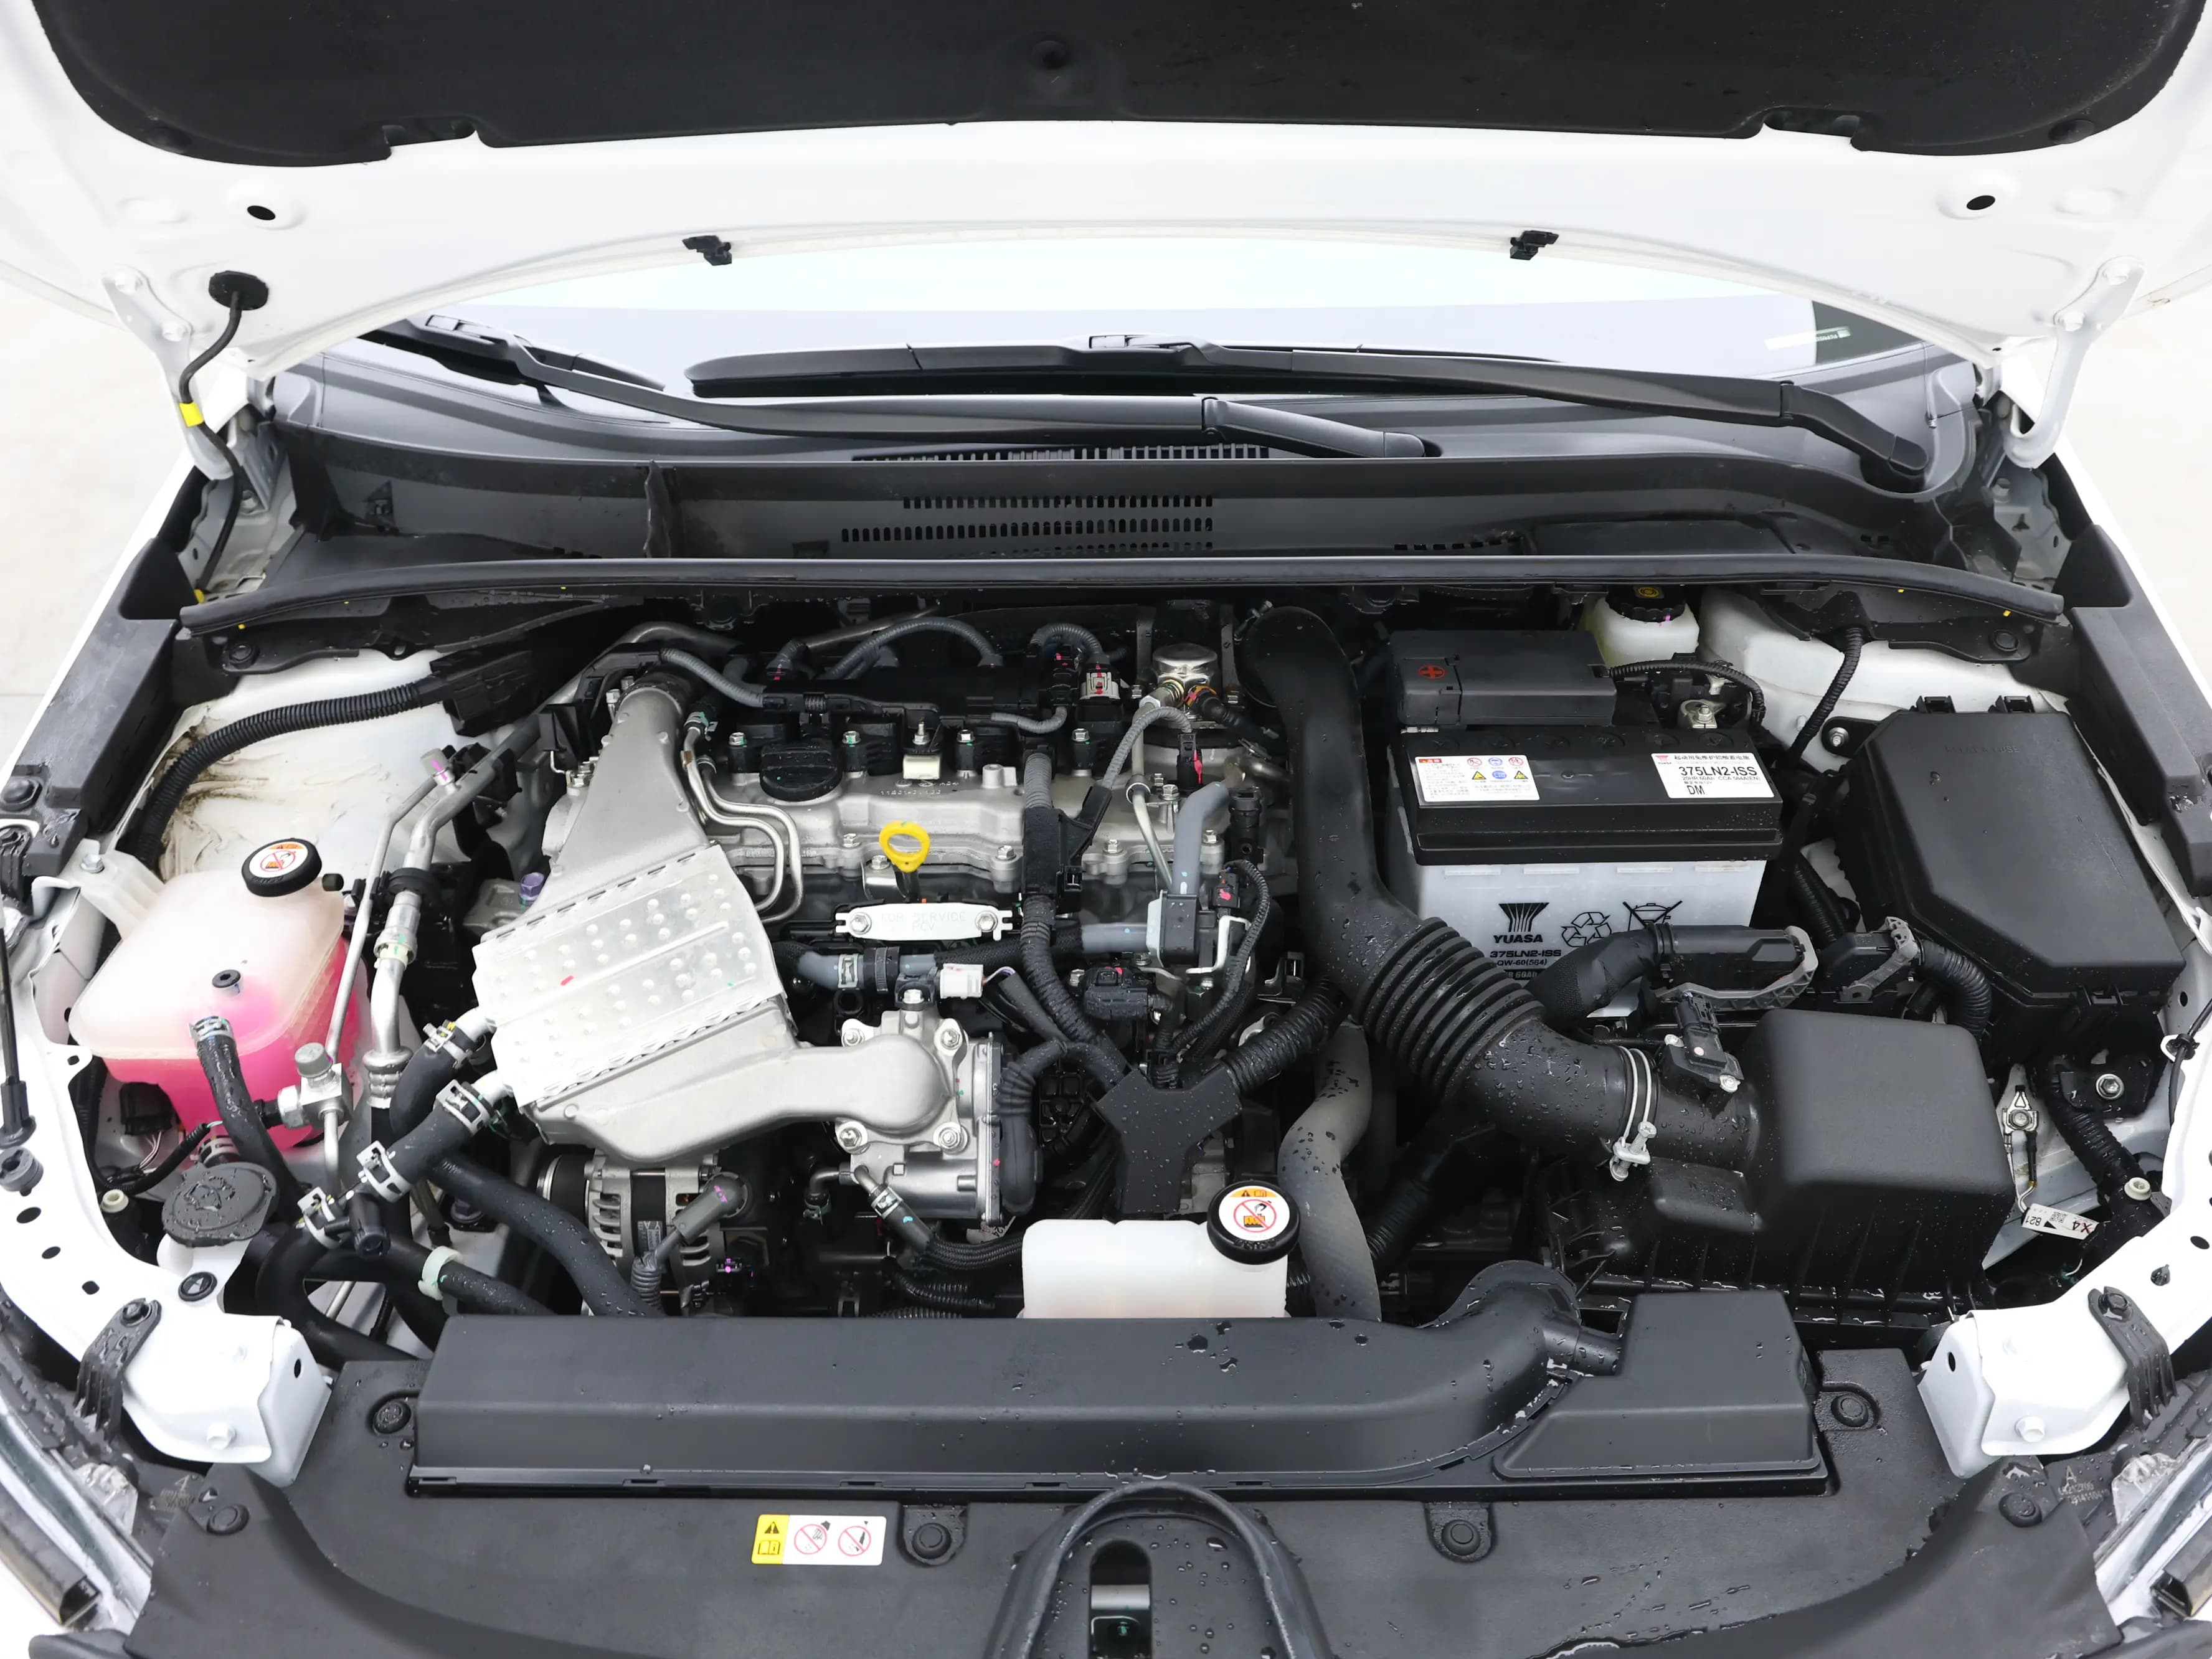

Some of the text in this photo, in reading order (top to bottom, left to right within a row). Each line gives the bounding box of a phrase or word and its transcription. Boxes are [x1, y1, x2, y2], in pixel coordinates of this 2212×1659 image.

[1678, 766, 1757, 777] 375LN2-ISS
[1686, 785, 1706, 795] DM
[912, 911, 967, 922] SERVICE
[912, 921, 936, 932] PCV
[1493, 933, 1544, 944] YUASA
[1489, 949, 1562, 958] 375LN2-ISS
[2025, 1216, 2093, 1234] X4 821
